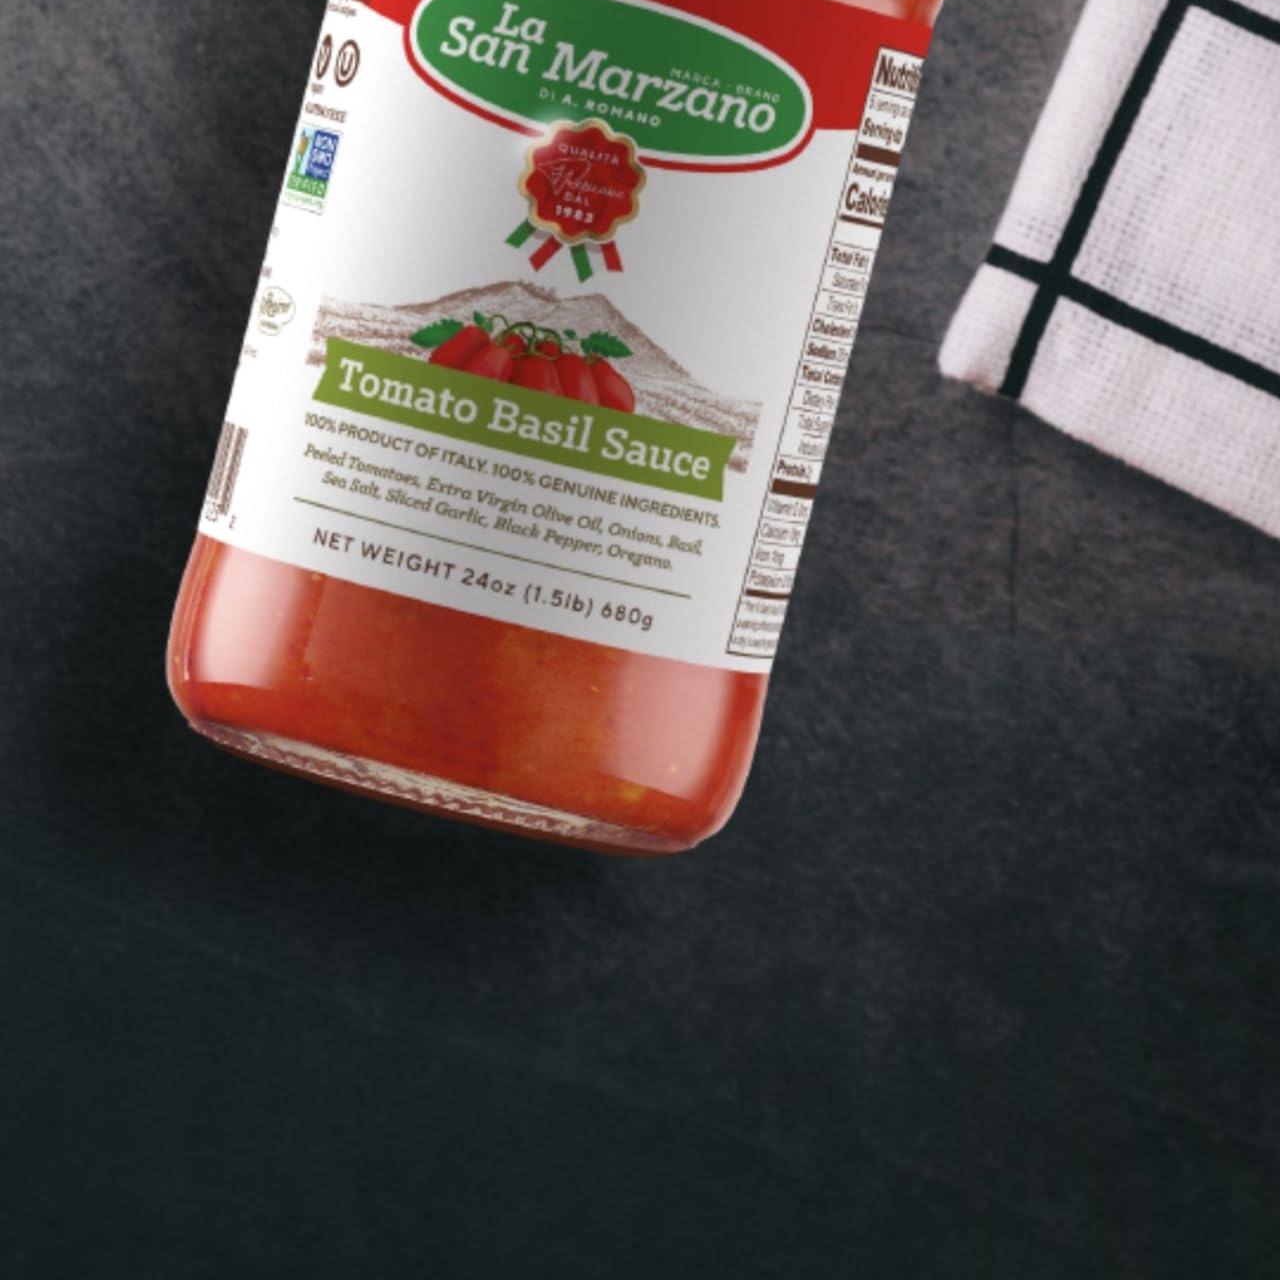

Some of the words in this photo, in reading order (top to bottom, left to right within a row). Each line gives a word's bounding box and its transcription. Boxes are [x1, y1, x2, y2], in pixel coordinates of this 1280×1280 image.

[493, 2, 547, 45] La
[440, 16, 531, 74] San
[542, 42, 776, 133] Marzano
[539, 88, 556, 101] DI
[584, 100, 662, 128] ROMANO
[669, 67, 721, 88] MARCA
[563, 192, 590, 206] DAL
[338, 357, 478, 423] Tomato
[487, 398, 593, 453] Basil
[601, 428, 710, 480] Sauce
[304, 412, 337, 434] 100%
[337, 421, 413, 453] PRODUCT
[414, 442, 440, 460] OF
[492, 463, 535, 486] 100%
[538, 475, 618, 505] GENUINE
[620, 494, 720, 529] INGREDIENTS.
[304, 443, 347, 467] Peeled
[426, 477, 472, 500] Extra
[476, 489, 528, 515] Virgin
[532, 504, 574, 526] Olive
[608, 523, 664, 548] Onions,
[321, 471, 347, 489] Sea
[384, 488, 433, 512] Sliced
[493, 516, 540, 539] Black
[313, 528, 355, 552] NET
[361, 542, 456, 579] WEIGHT
[460, 568, 516, 596] 24oz
[523, 584, 594, 618] (1.5lb)
[600, 602, 655, 631] 680g
